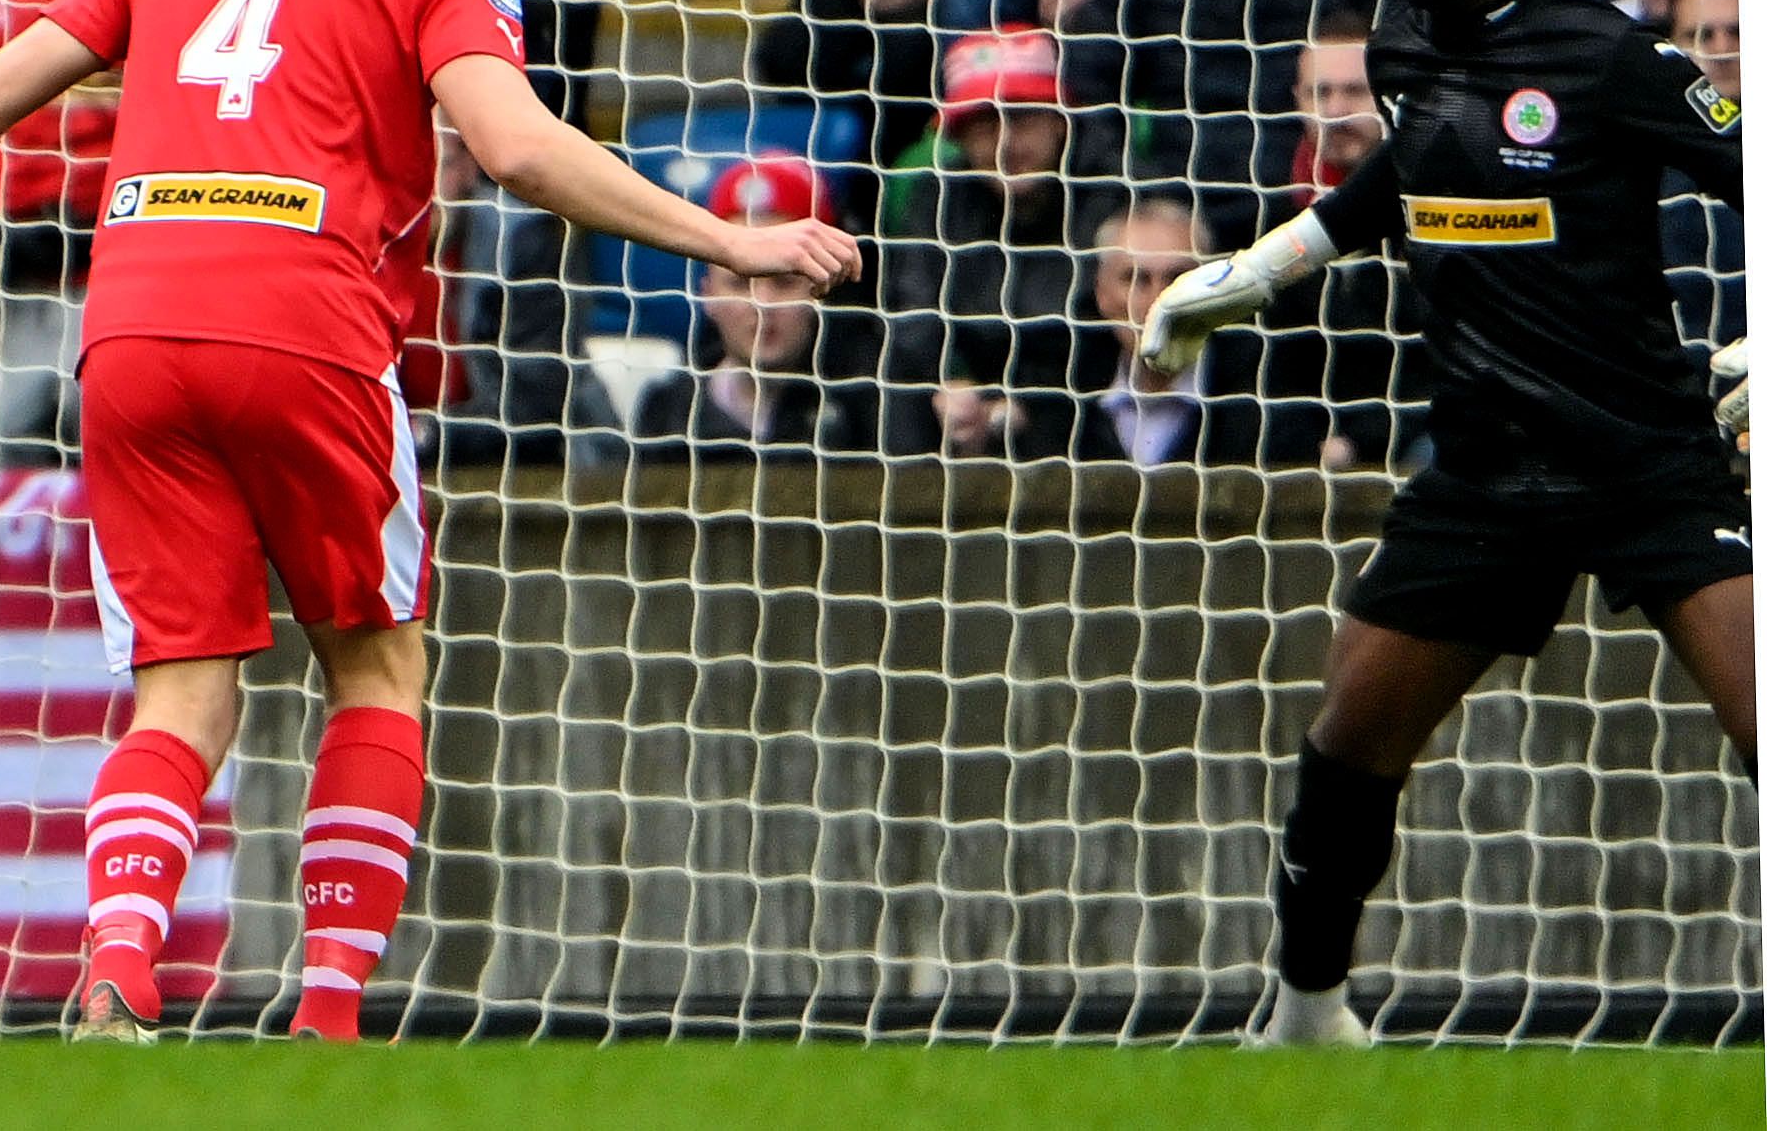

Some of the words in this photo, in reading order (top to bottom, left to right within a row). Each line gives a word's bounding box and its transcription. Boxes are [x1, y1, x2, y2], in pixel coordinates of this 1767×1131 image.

[1709, 97, 1739, 124] CA
[147, 188, 206, 205] SEAN
[209, 188, 309, 211] GRAHAM
[1452, 212, 1538, 229] GRAHAM
[105, 854, 164, 877] CFC
[304, 882, 354, 905] CFC
